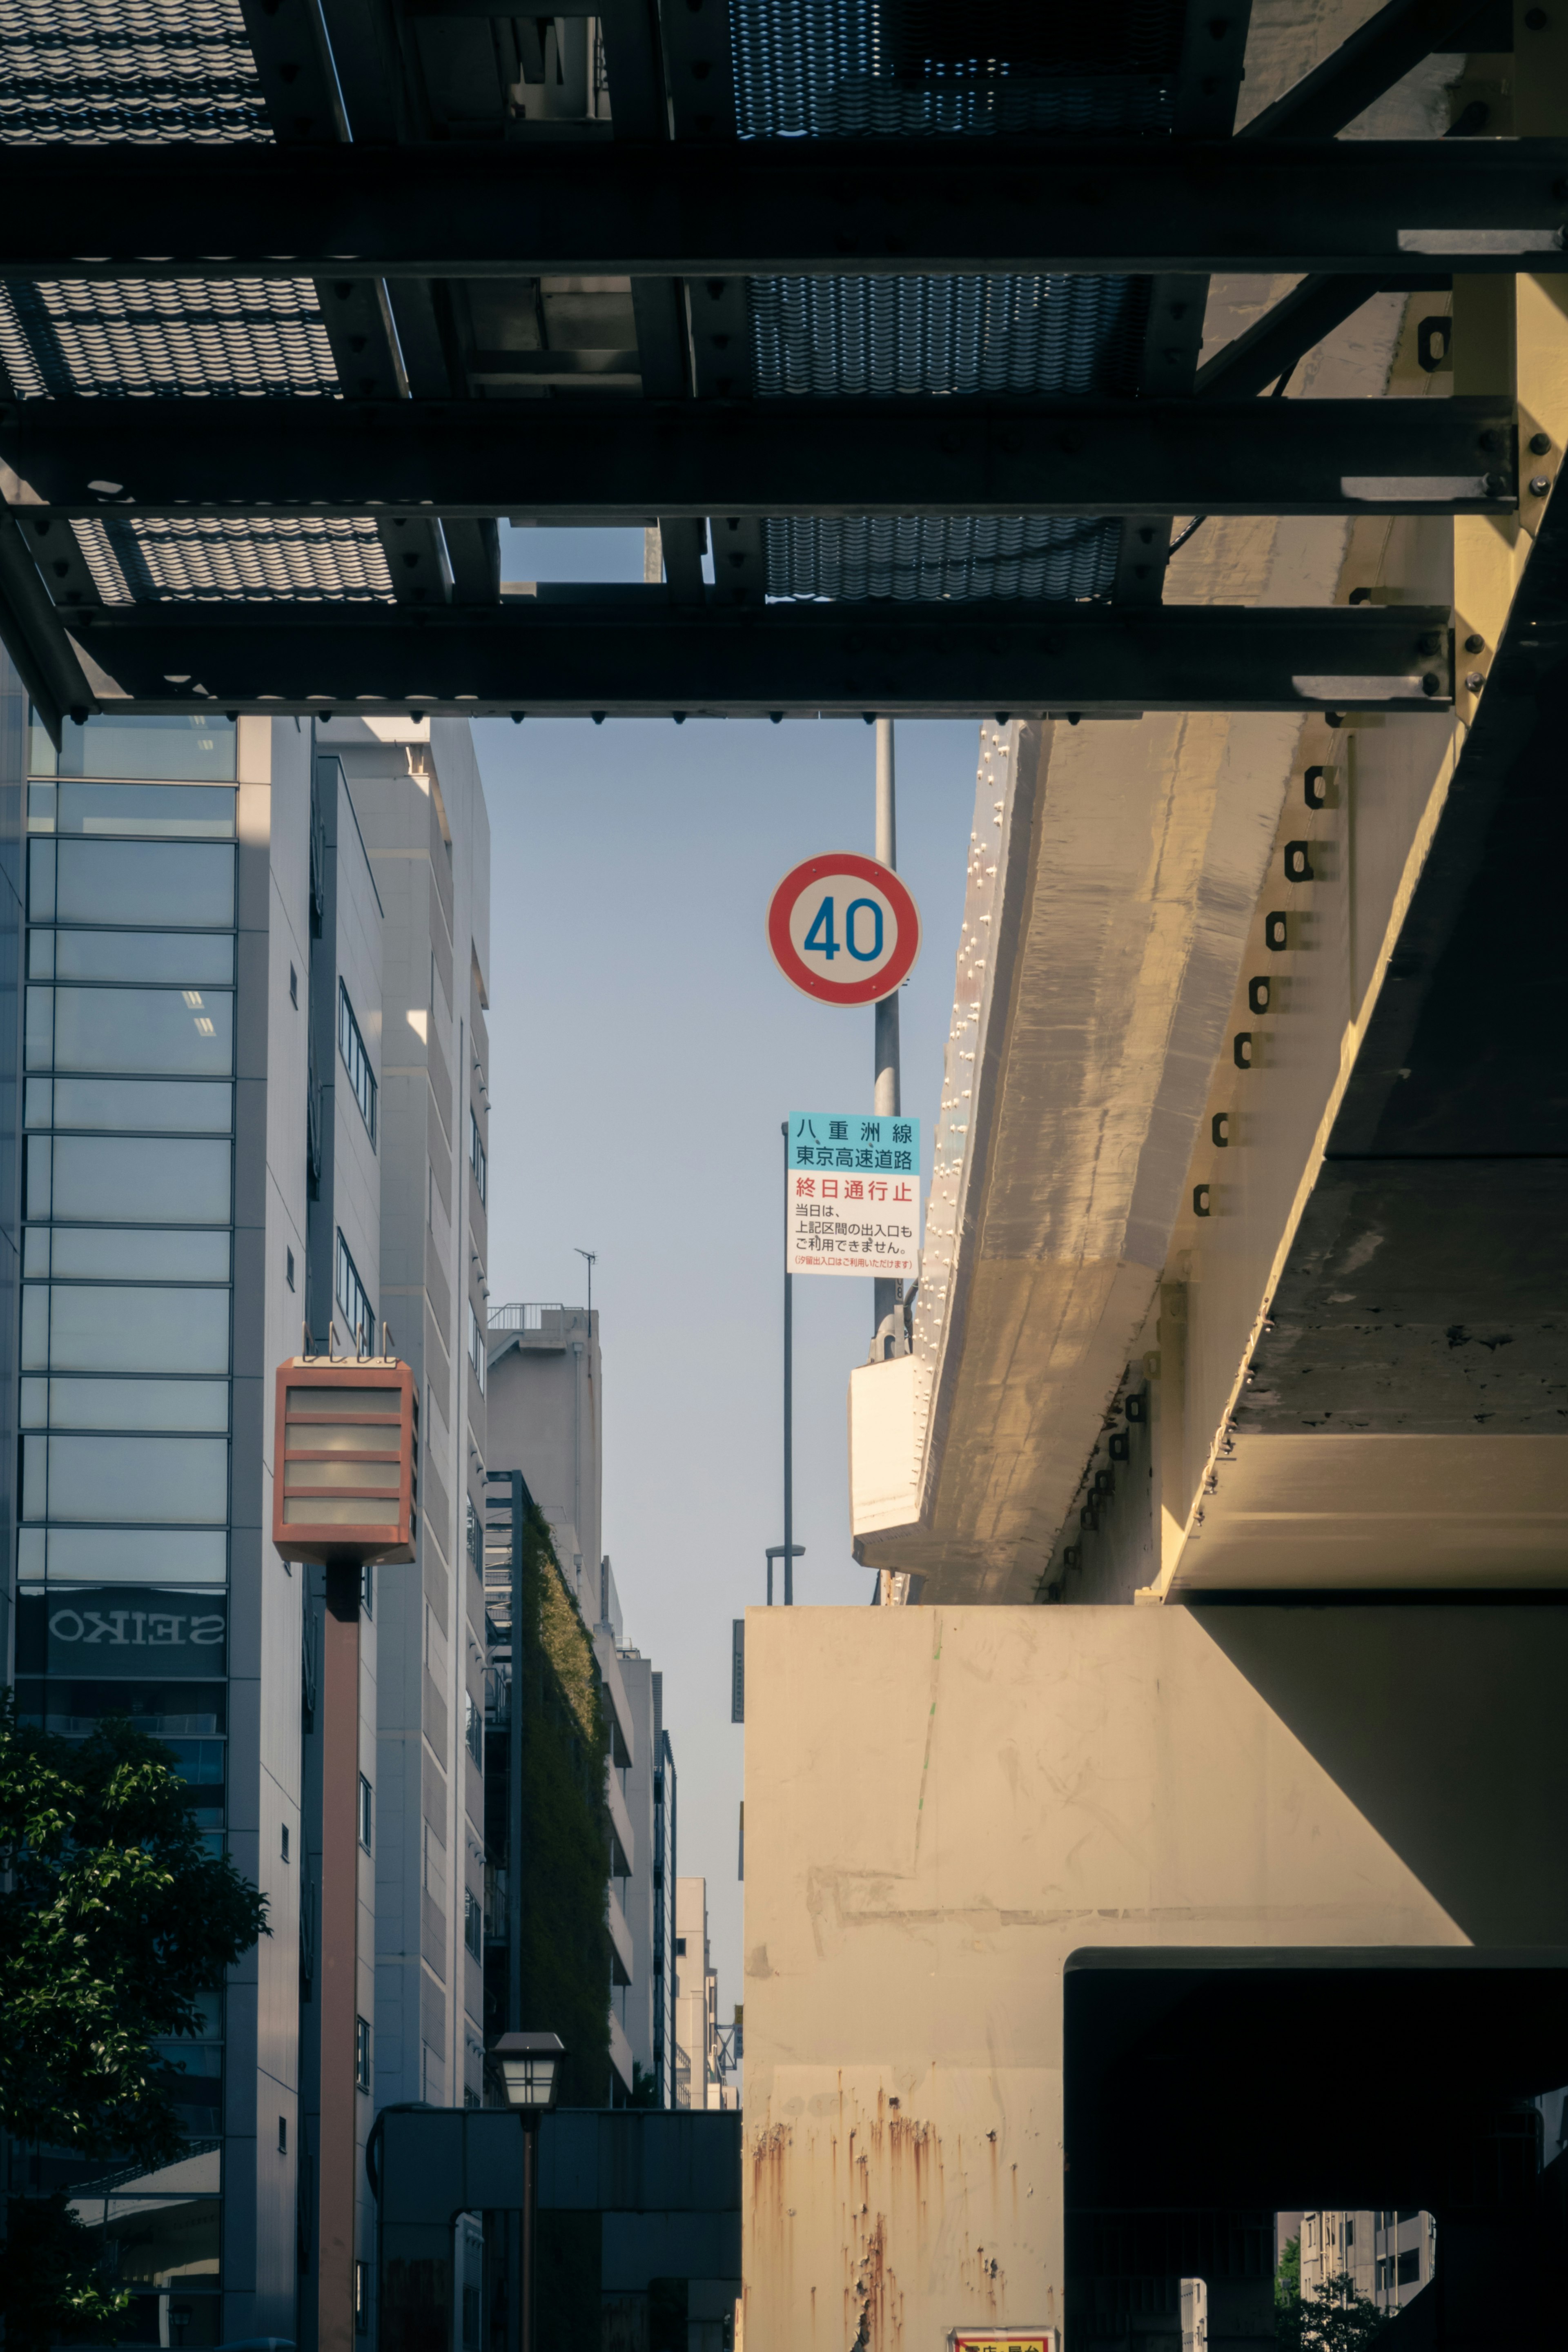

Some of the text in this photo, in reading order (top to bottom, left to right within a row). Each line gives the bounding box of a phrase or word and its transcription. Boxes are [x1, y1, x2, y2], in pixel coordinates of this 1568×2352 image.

[804, 896, 883, 962] 40
[797, 1119, 912, 1143] 八重洲線
[796, 1145, 912, 1170] 東京高速道路
[796, 1177, 912, 1202] 終日通行止
[795, 1203, 839, 1217] 当日は、
[795, 1220, 912, 1238] 上記区間の出入口も
[796, 1238, 905, 1254] ご利用できません。
